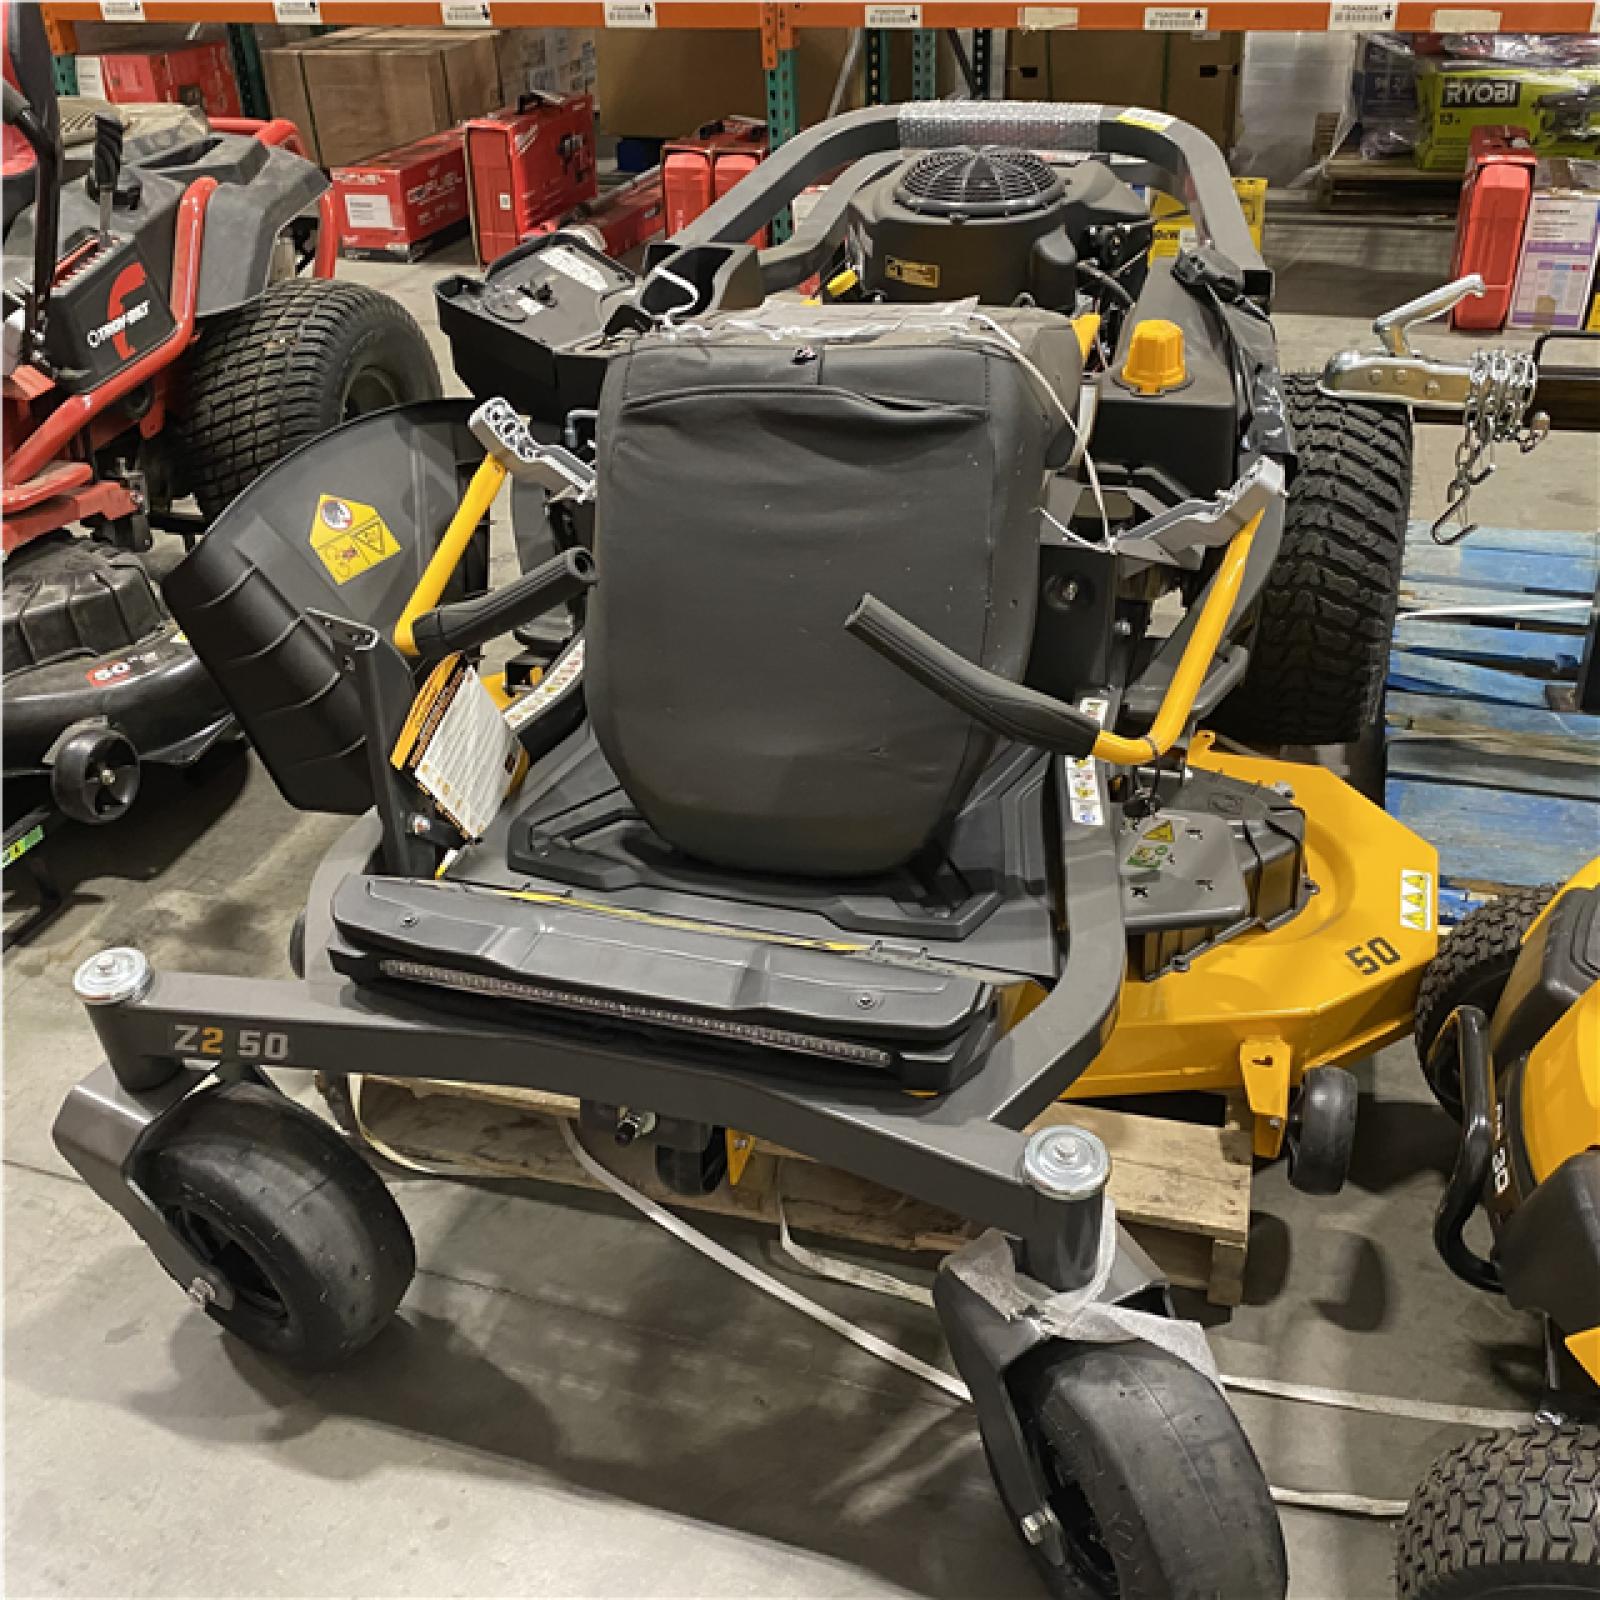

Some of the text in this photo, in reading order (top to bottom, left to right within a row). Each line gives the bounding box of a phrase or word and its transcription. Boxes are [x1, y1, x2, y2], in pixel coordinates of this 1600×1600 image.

[1446, 81, 1516, 104] RYOBI
[1344, 936, 1401, 976] 50
[173, 1024, 289, 1060] Z2 50
